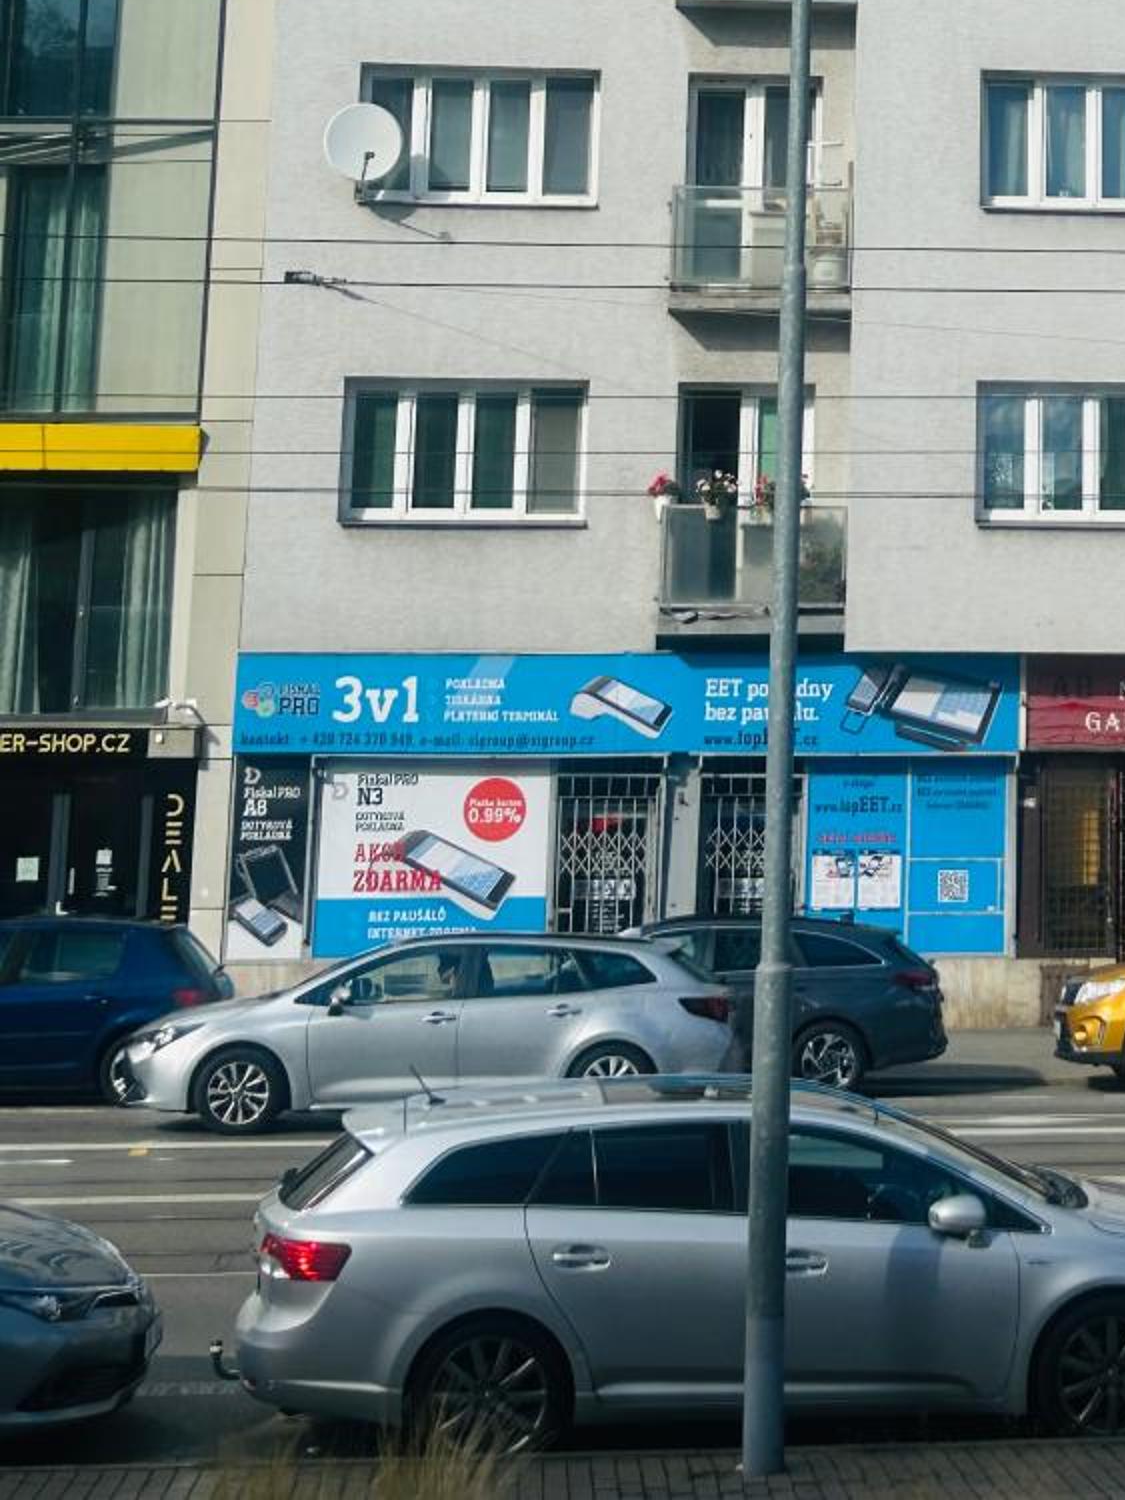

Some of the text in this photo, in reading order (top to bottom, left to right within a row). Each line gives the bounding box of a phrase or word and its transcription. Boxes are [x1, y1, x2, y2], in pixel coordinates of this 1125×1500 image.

[332, 675, 419, 723] 3v1
[704, 678, 834, 702] EET podny
[280, 698, 321, 715] PRO
[502, 708, 560, 722] TERMINÁL
[704, 700, 738, 721] bez
[357, 787, 383, 806] N3
[353, 869, 443, 893] ZDARMA
